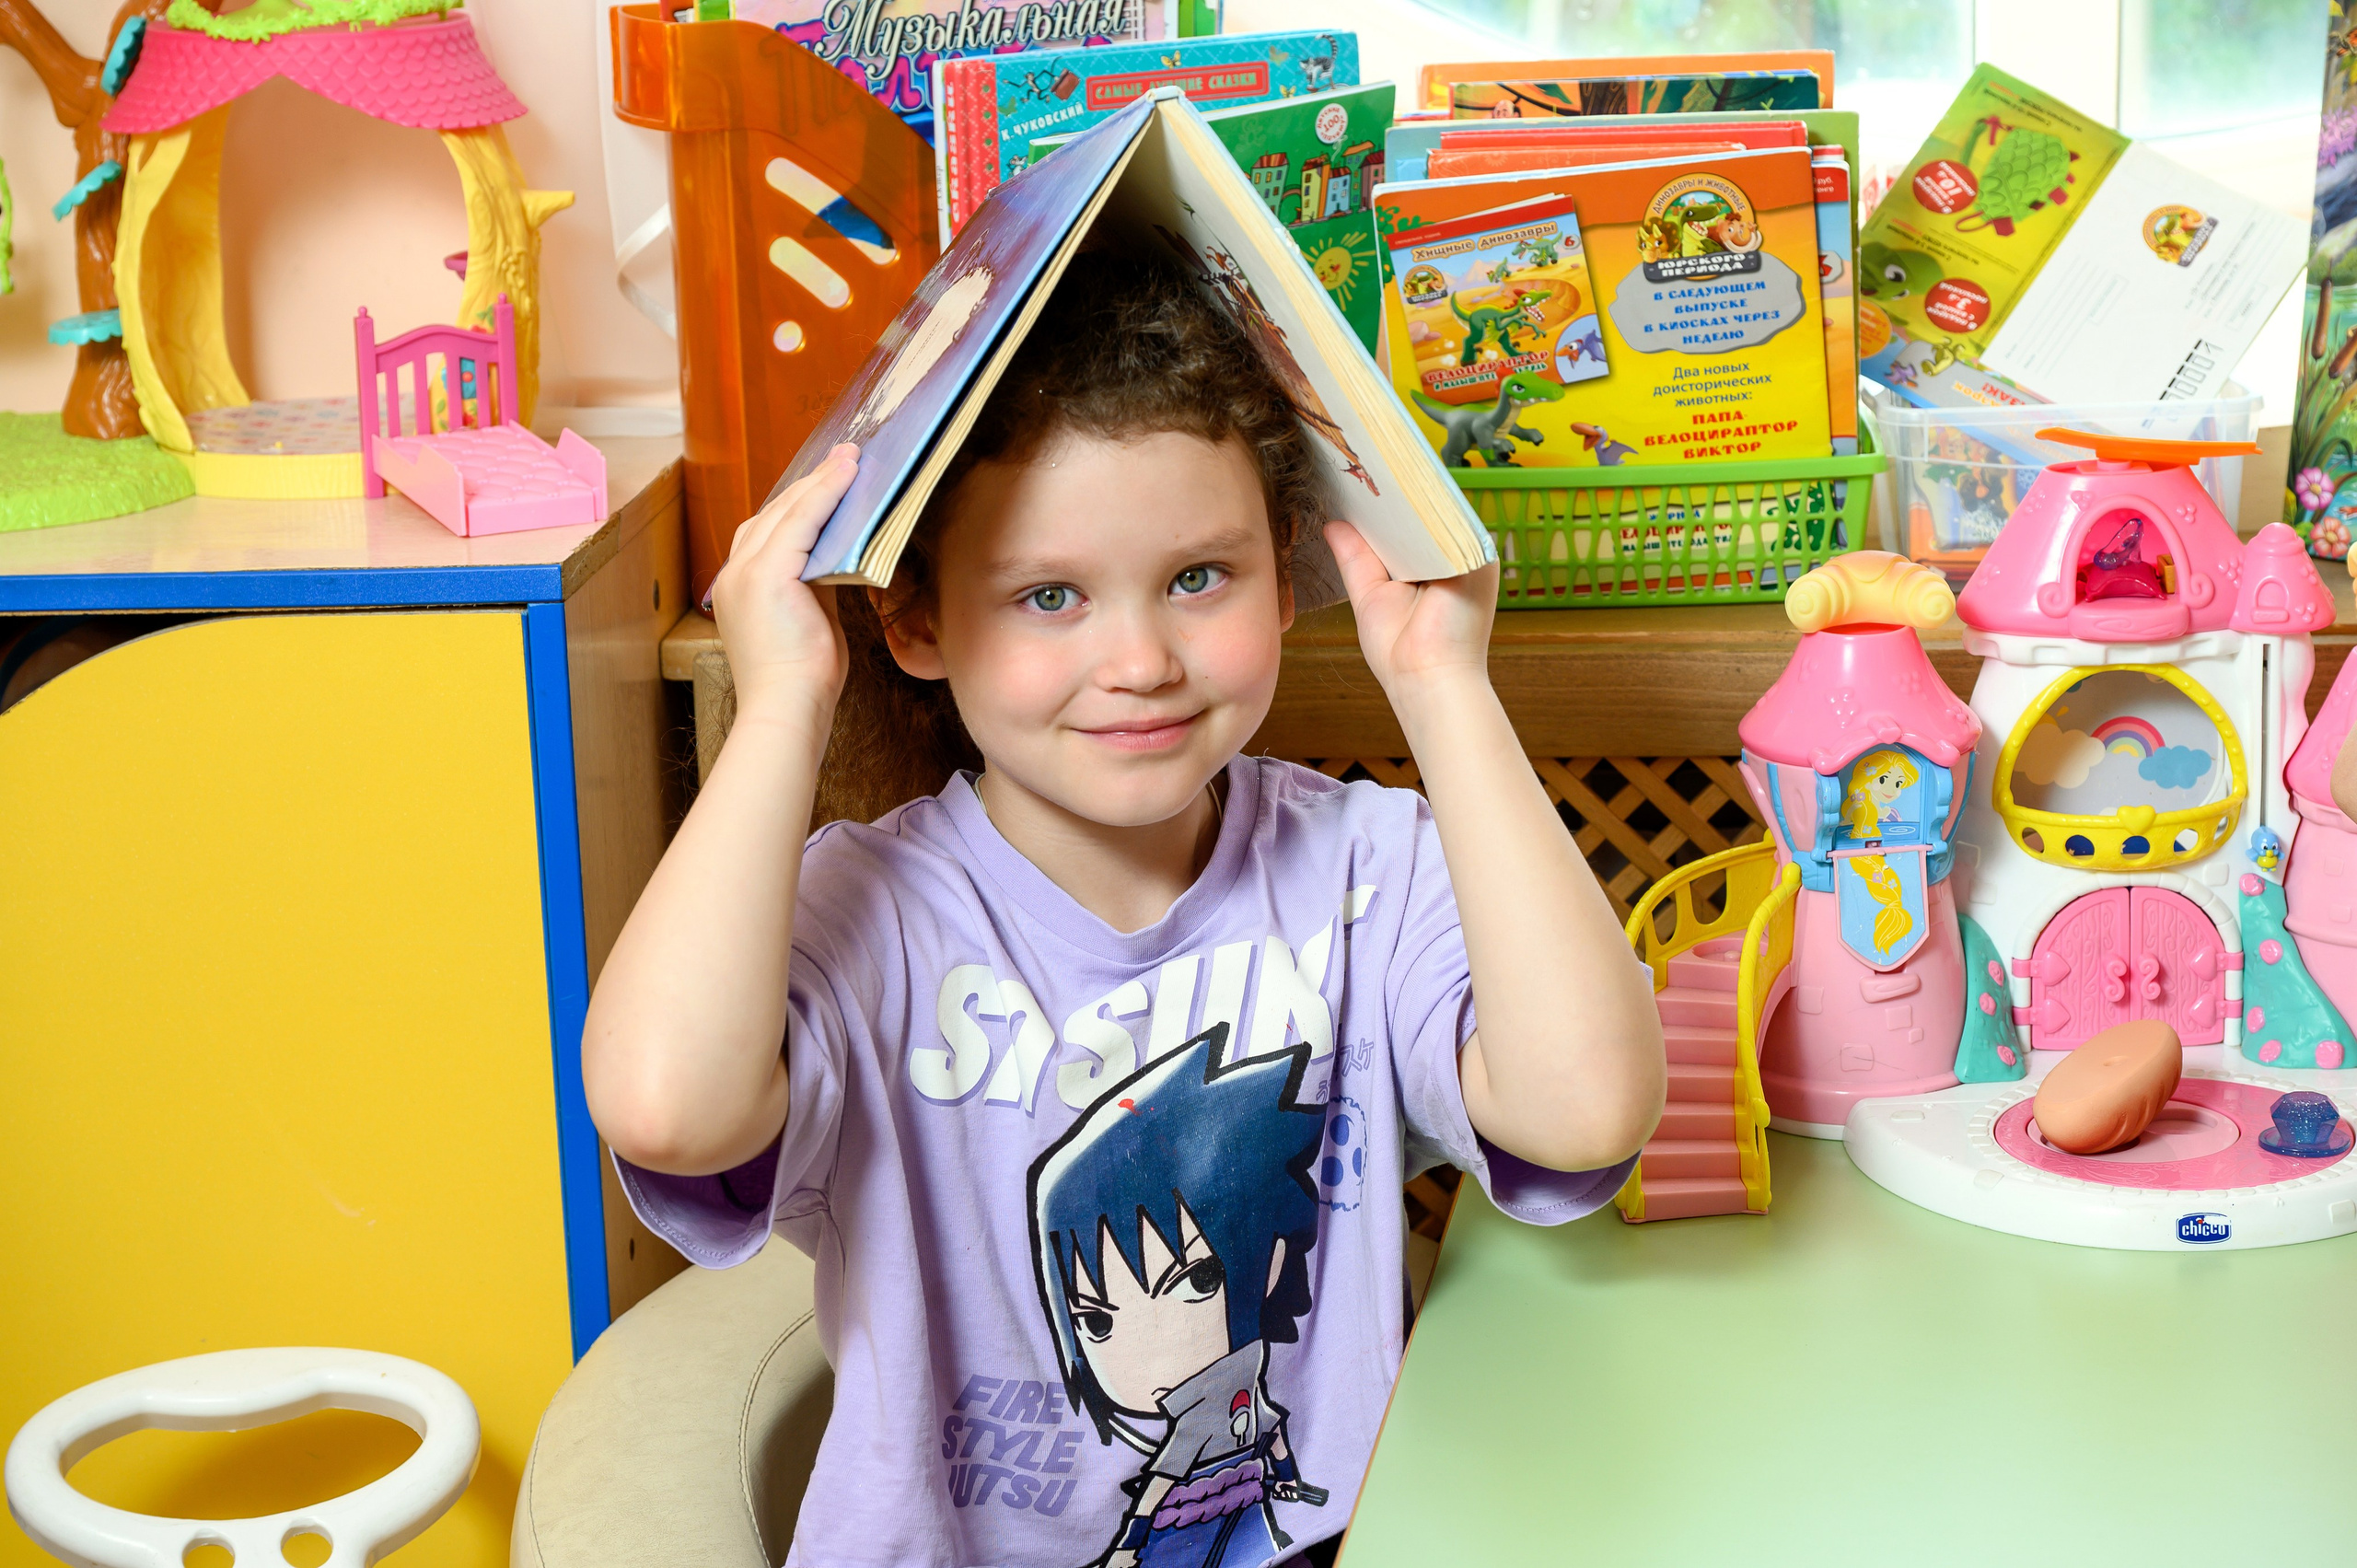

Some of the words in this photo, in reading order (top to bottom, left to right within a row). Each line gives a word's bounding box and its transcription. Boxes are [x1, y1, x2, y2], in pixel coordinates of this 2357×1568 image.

[814, 0, 1126, 81] Музыкальная
[1095, 82, 1144, 100] САМЫЕ
[1208, 72, 1258, 89] СКАЗКИ
[1652, 178, 1696, 215] ДИНОЗАВРЫ
[1697, 178, 1704, 188] И
[1705, 178, 1747, 212] ЖИВОТНЫЕ
[1415, 239, 1473, 261] Хищные
[1657, 253, 1747, 270] ЮРСКОГО
[1661, 262, 1744, 277] ПЕРИОДА
[1668, 281, 1767, 300] СЛЕДУЮЩЕМ
[1674, 297, 1748, 314] ВЫПУСКЕ
[1658, 316, 1729, 332] КИОСКАХ
[1734, 310, 1781, 323] ЧЕРЕЗ
[1682, 330, 1745, 344] НЕДЕЛЮ
[1427, 350, 1550, 382] ВЕЛОЦИРАПТОР
[1672, 366, 1701, 381] Два
[1703, 362, 1750, 376] новых
[1653, 374, 1772, 397] доисторических
[1675, 390, 1753, 407] животных:
[1644, 420, 1798, 447] ВЕЛОЦИРАПТОР
[1683, 441, 1762, 459] ВИКТОР
[2181, 1217, 2226, 1237] chicco
[952, 1374, 1067, 1424] FIRE
[941, 1414, 1086, 1474] STYLE
